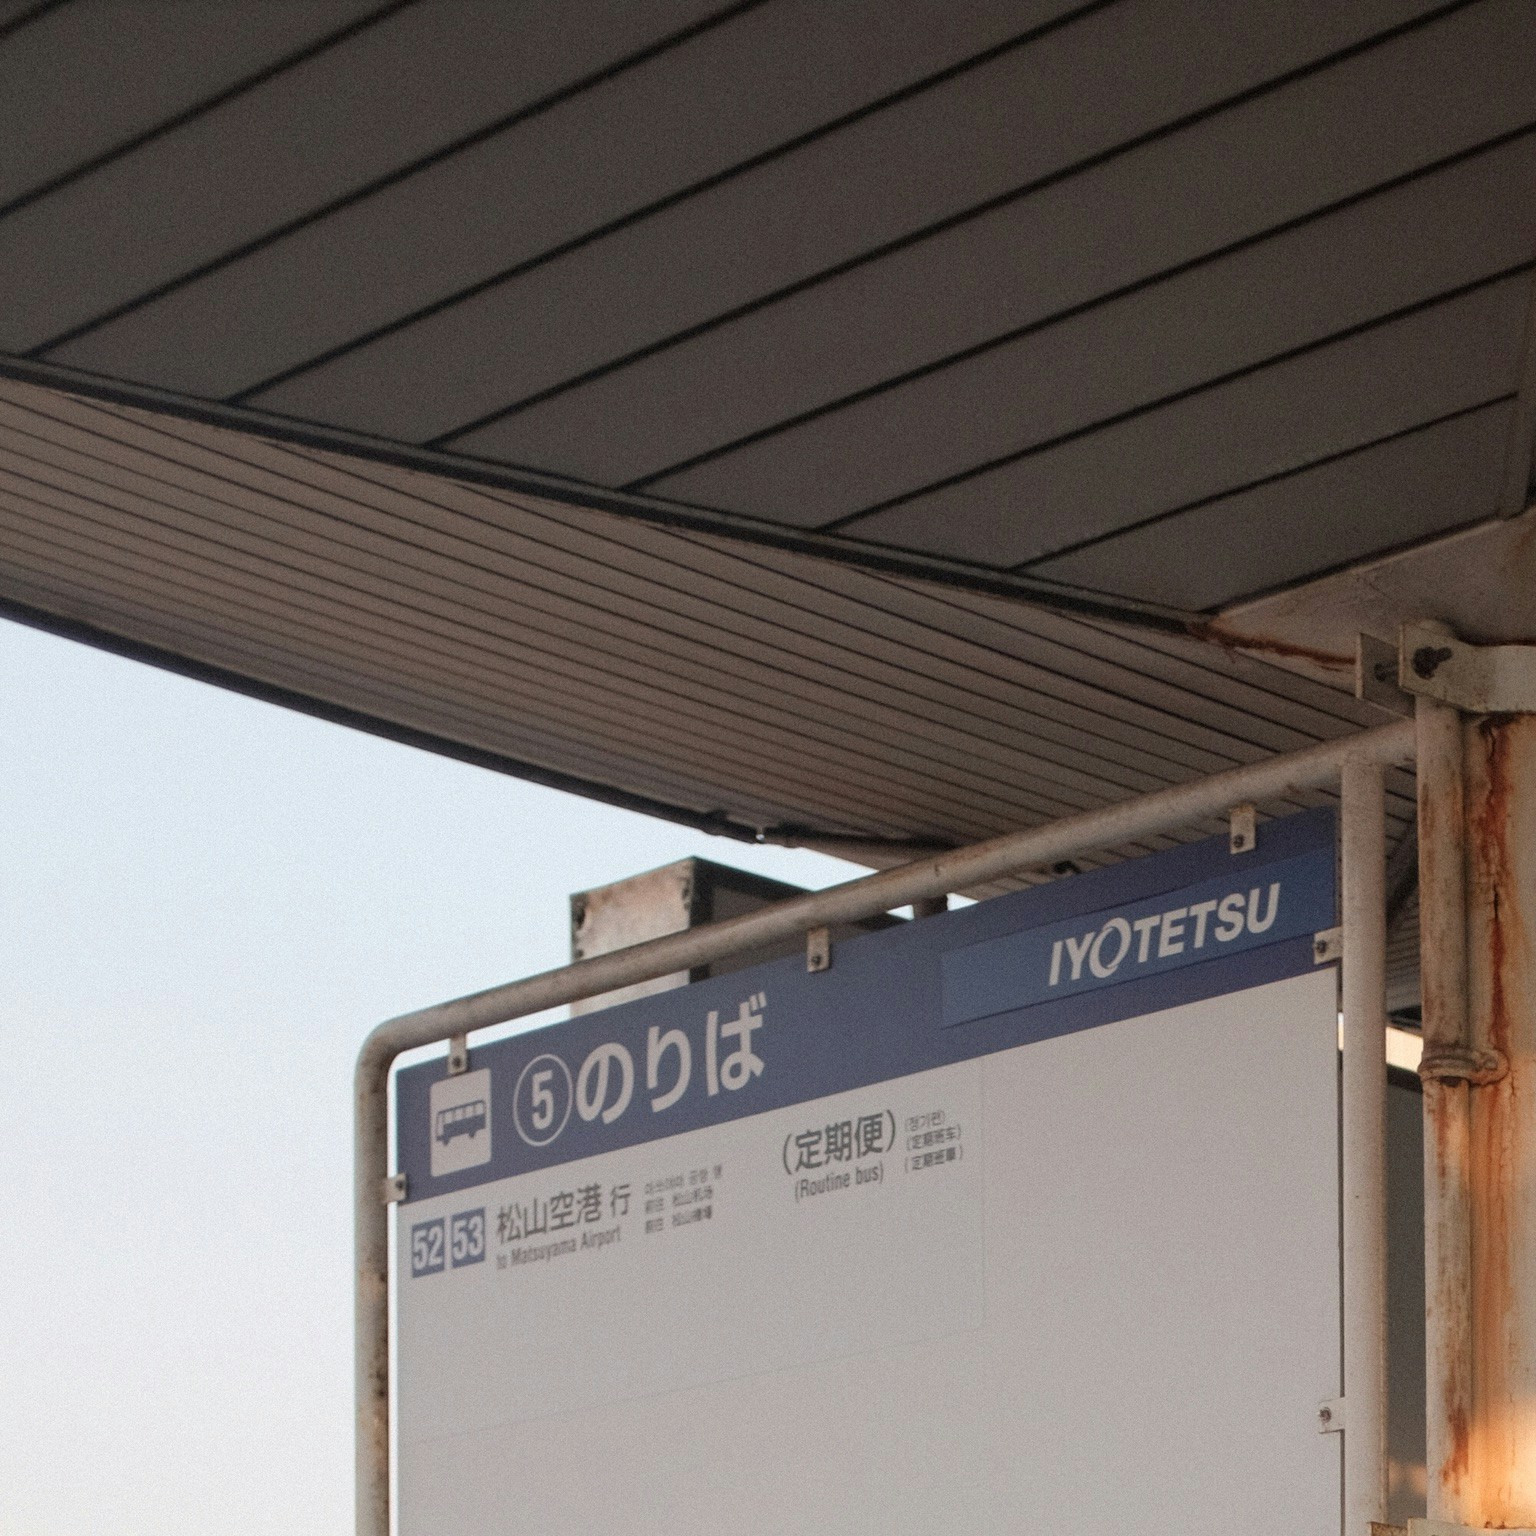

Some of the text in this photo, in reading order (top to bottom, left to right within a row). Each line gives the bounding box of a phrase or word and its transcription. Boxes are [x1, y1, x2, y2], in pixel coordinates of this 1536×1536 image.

[1049, 882, 1281, 987] IYOTETSU
[783, 1109, 896, 1175] (定期便)
[795, 1160, 884, 1203] (Routine bus)
[412, 1214, 485, 1271] 52 53
[496, 1182, 632, 1244] 松山空港 行
[511, 1238, 577, 1265] Matsuyama
[581, 1224, 622, 1251] Airport
